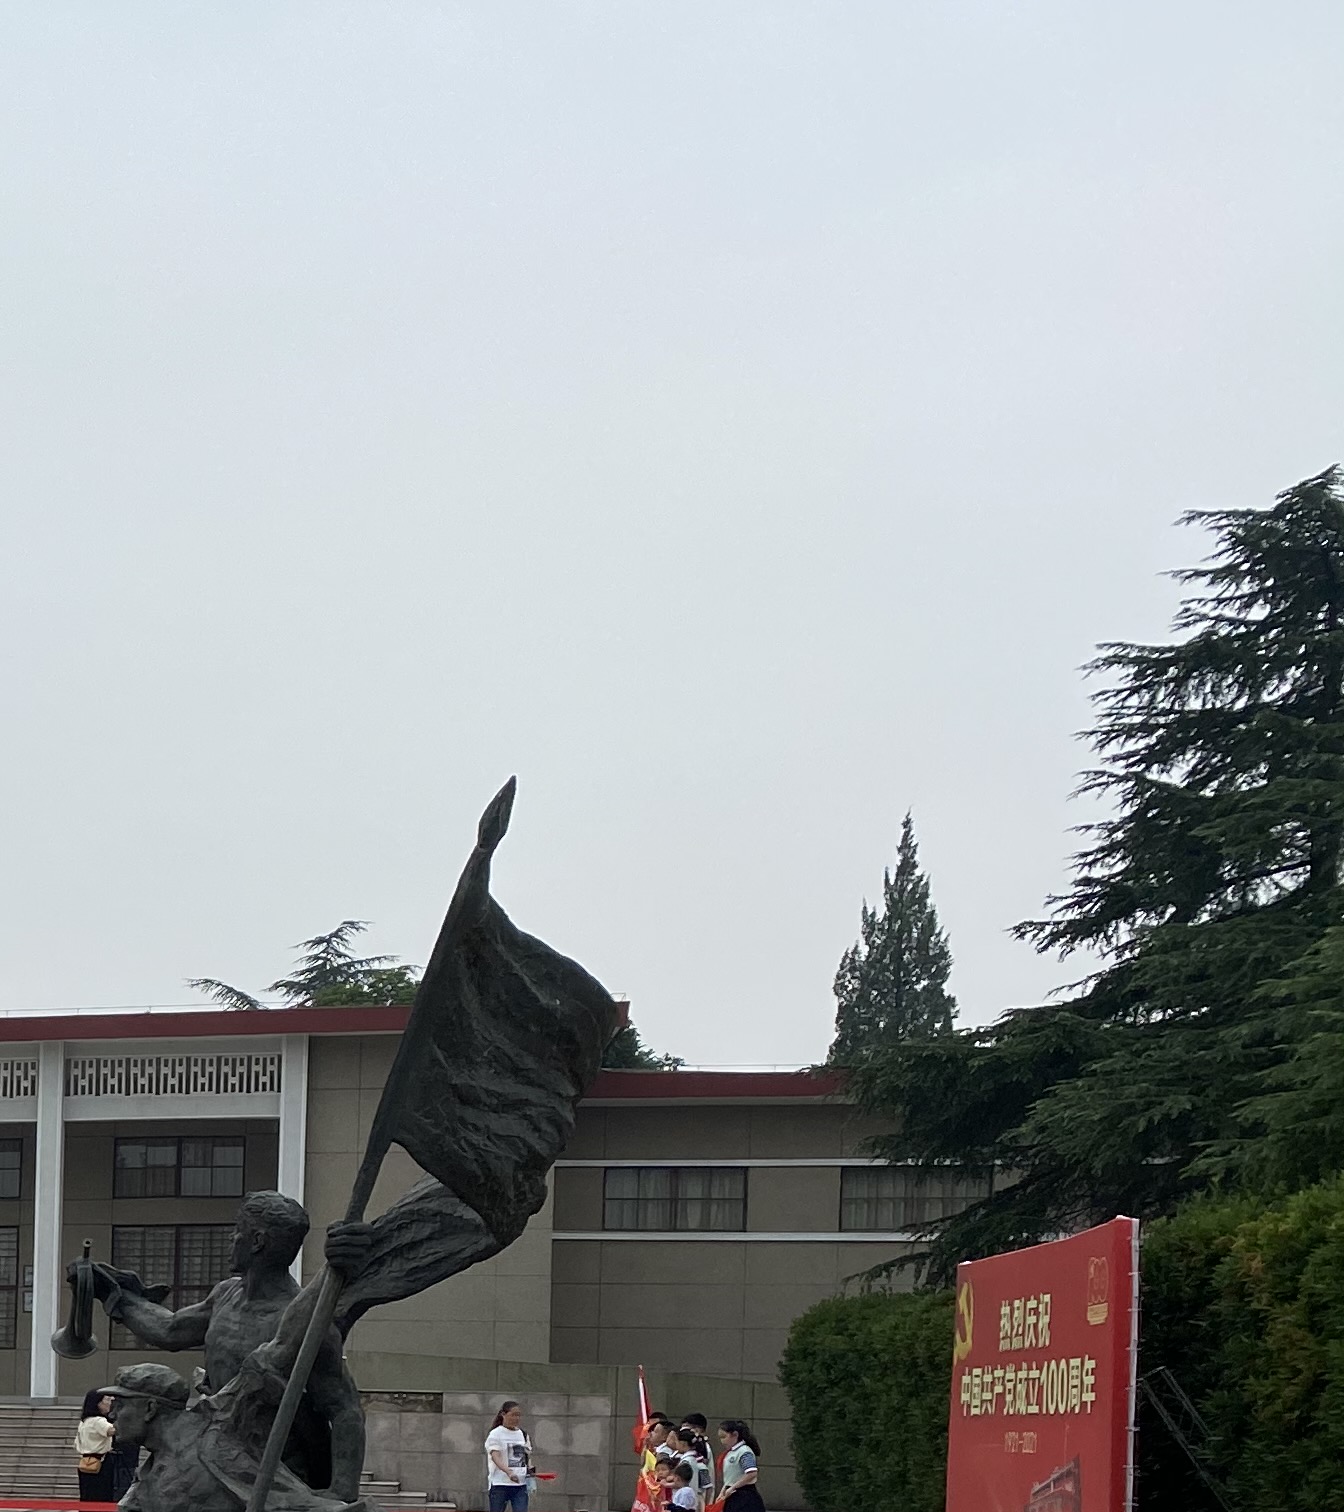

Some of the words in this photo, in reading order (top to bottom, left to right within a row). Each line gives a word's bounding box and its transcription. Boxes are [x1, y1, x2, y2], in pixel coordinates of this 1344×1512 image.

[999, 1292, 1051, 1352] 热烈庆祝
[961, 1354, 1096, 1416] 中国共产党成立100周年
